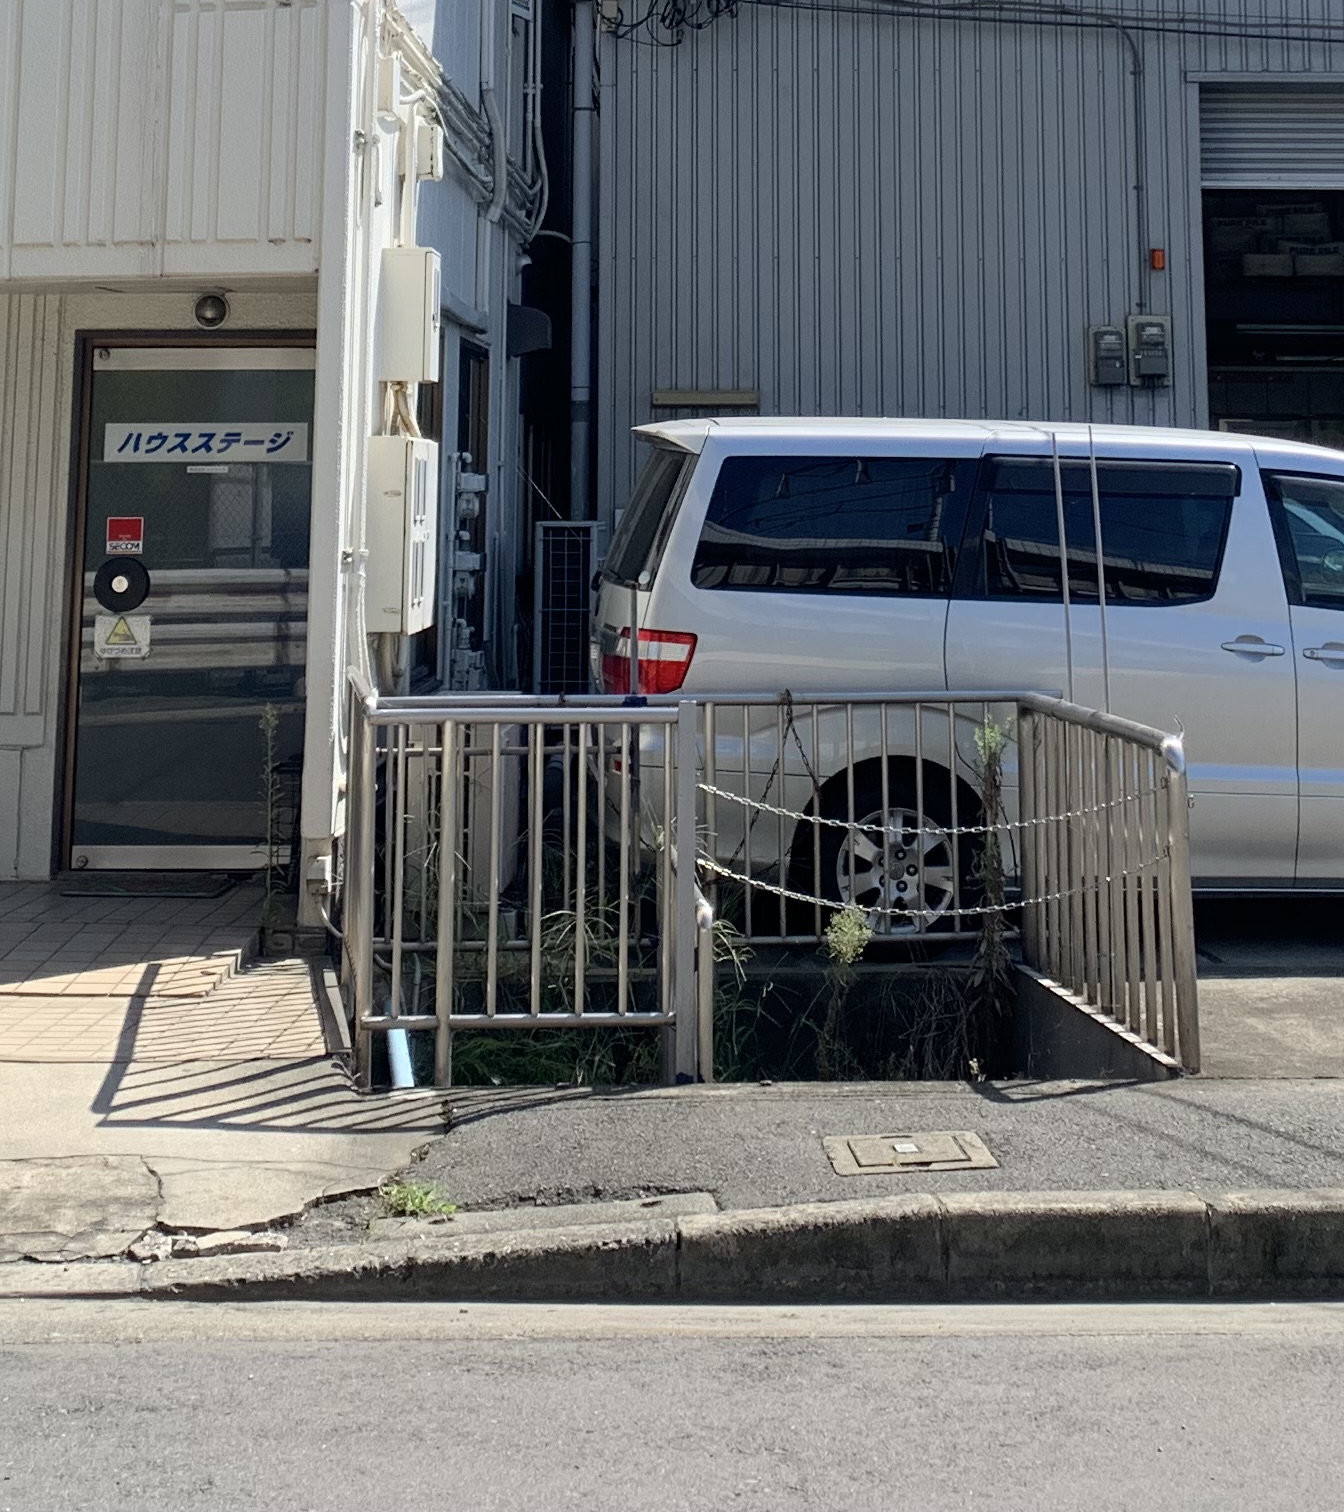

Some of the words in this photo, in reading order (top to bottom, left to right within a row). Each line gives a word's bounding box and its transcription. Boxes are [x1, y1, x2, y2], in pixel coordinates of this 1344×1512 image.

[117, 431, 294, 454] ハウスステージ
[109, 542, 140, 550] SECOM
